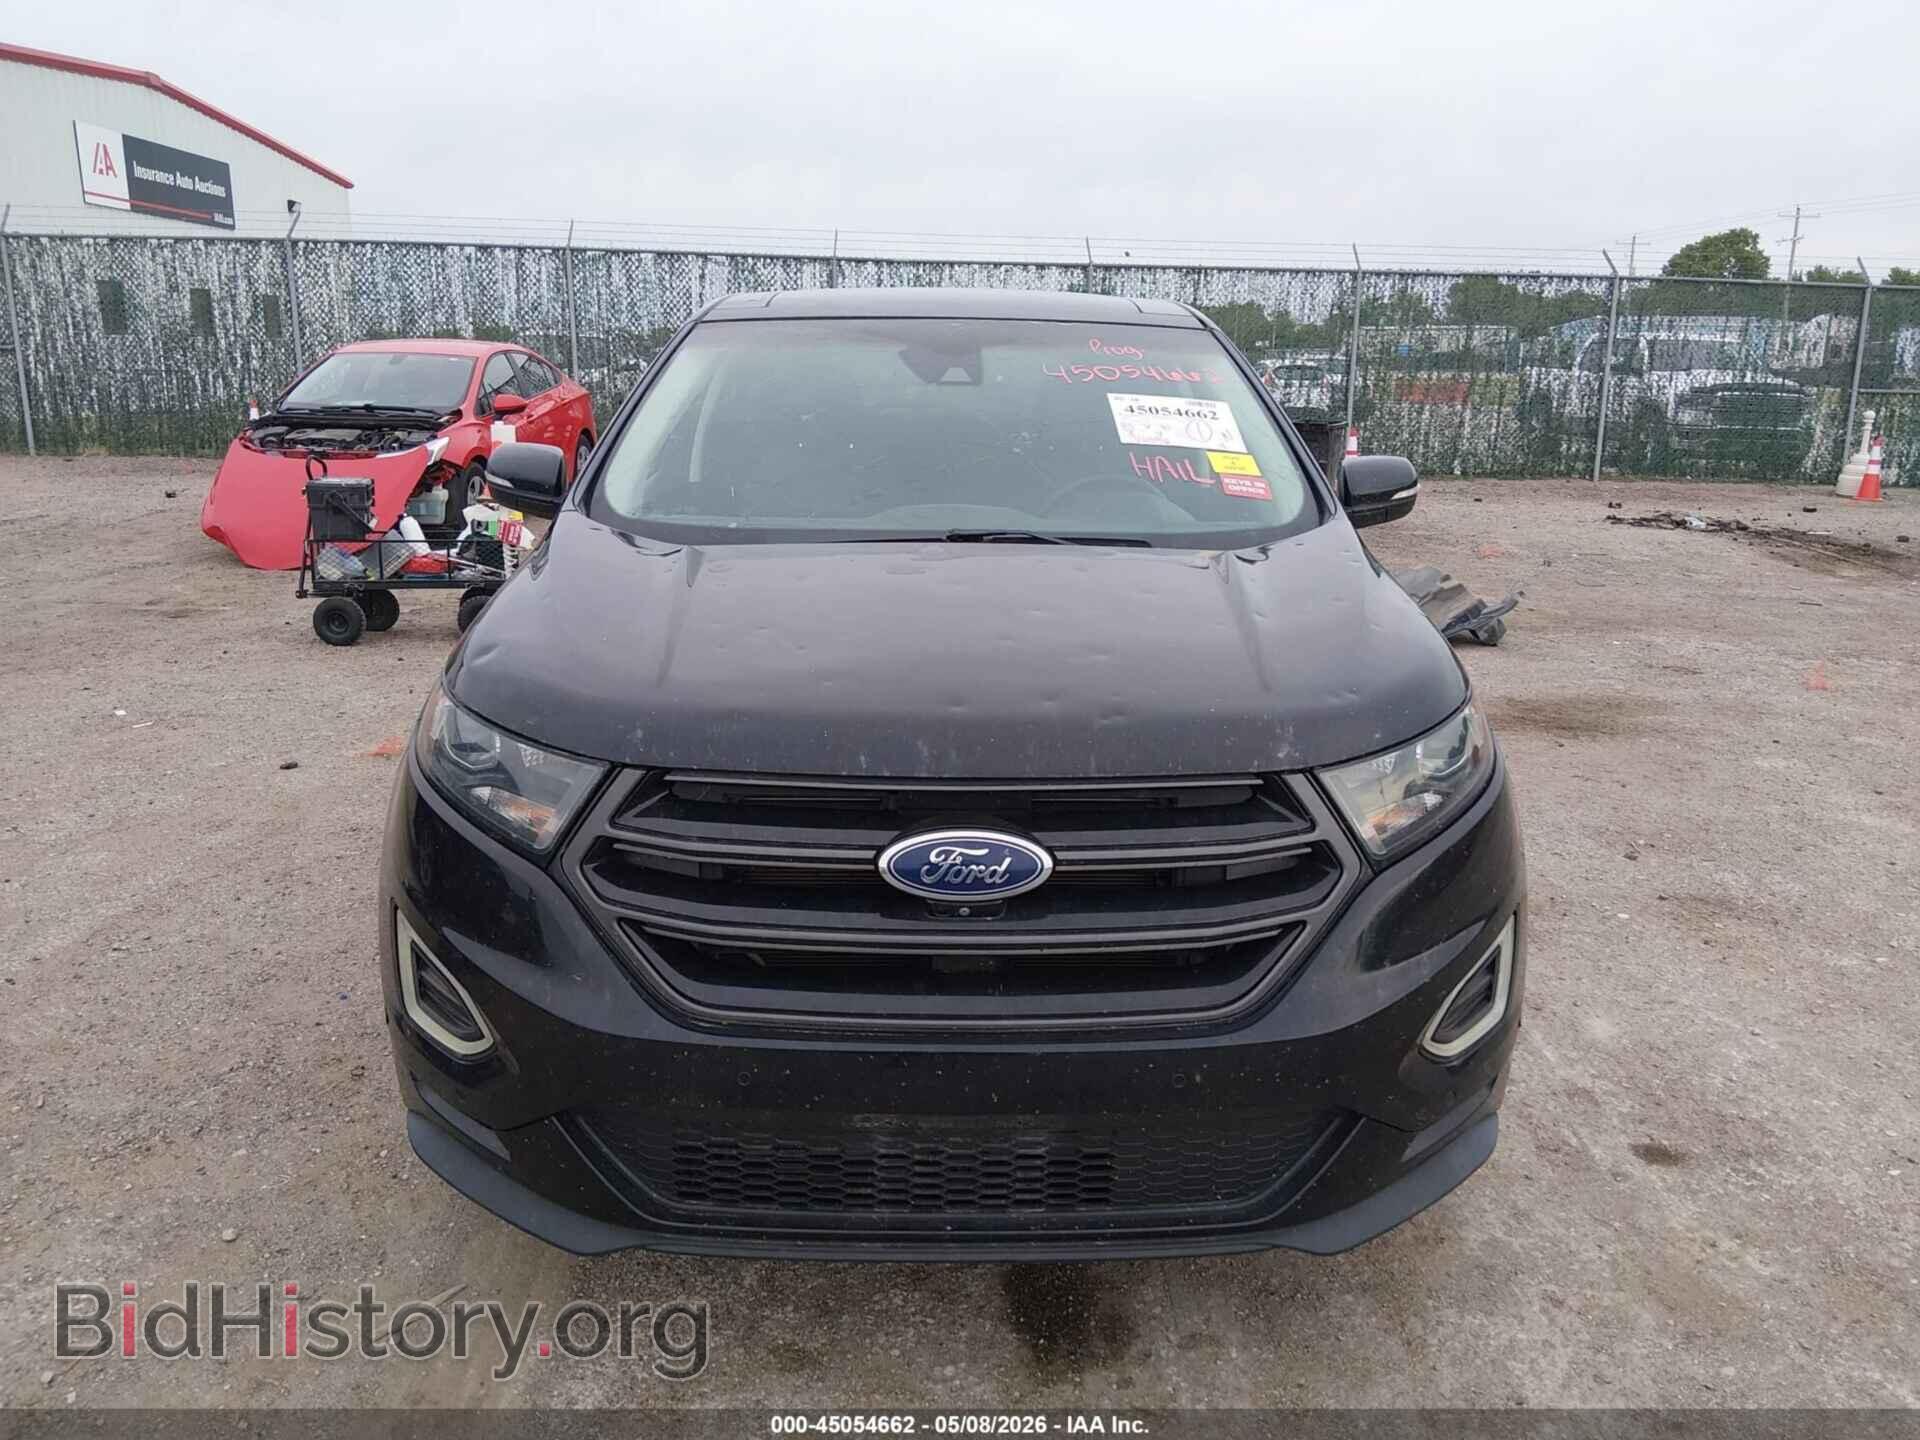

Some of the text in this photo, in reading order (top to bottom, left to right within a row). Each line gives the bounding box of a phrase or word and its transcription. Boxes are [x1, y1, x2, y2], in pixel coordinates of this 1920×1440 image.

[132, 160, 226, 198] Insurance Auto Auctions
[1123, 404, 1220, 421] 45054662
[1129, 451, 1216, 484] HAIL
[920, 846, 1013, 884] Ford
